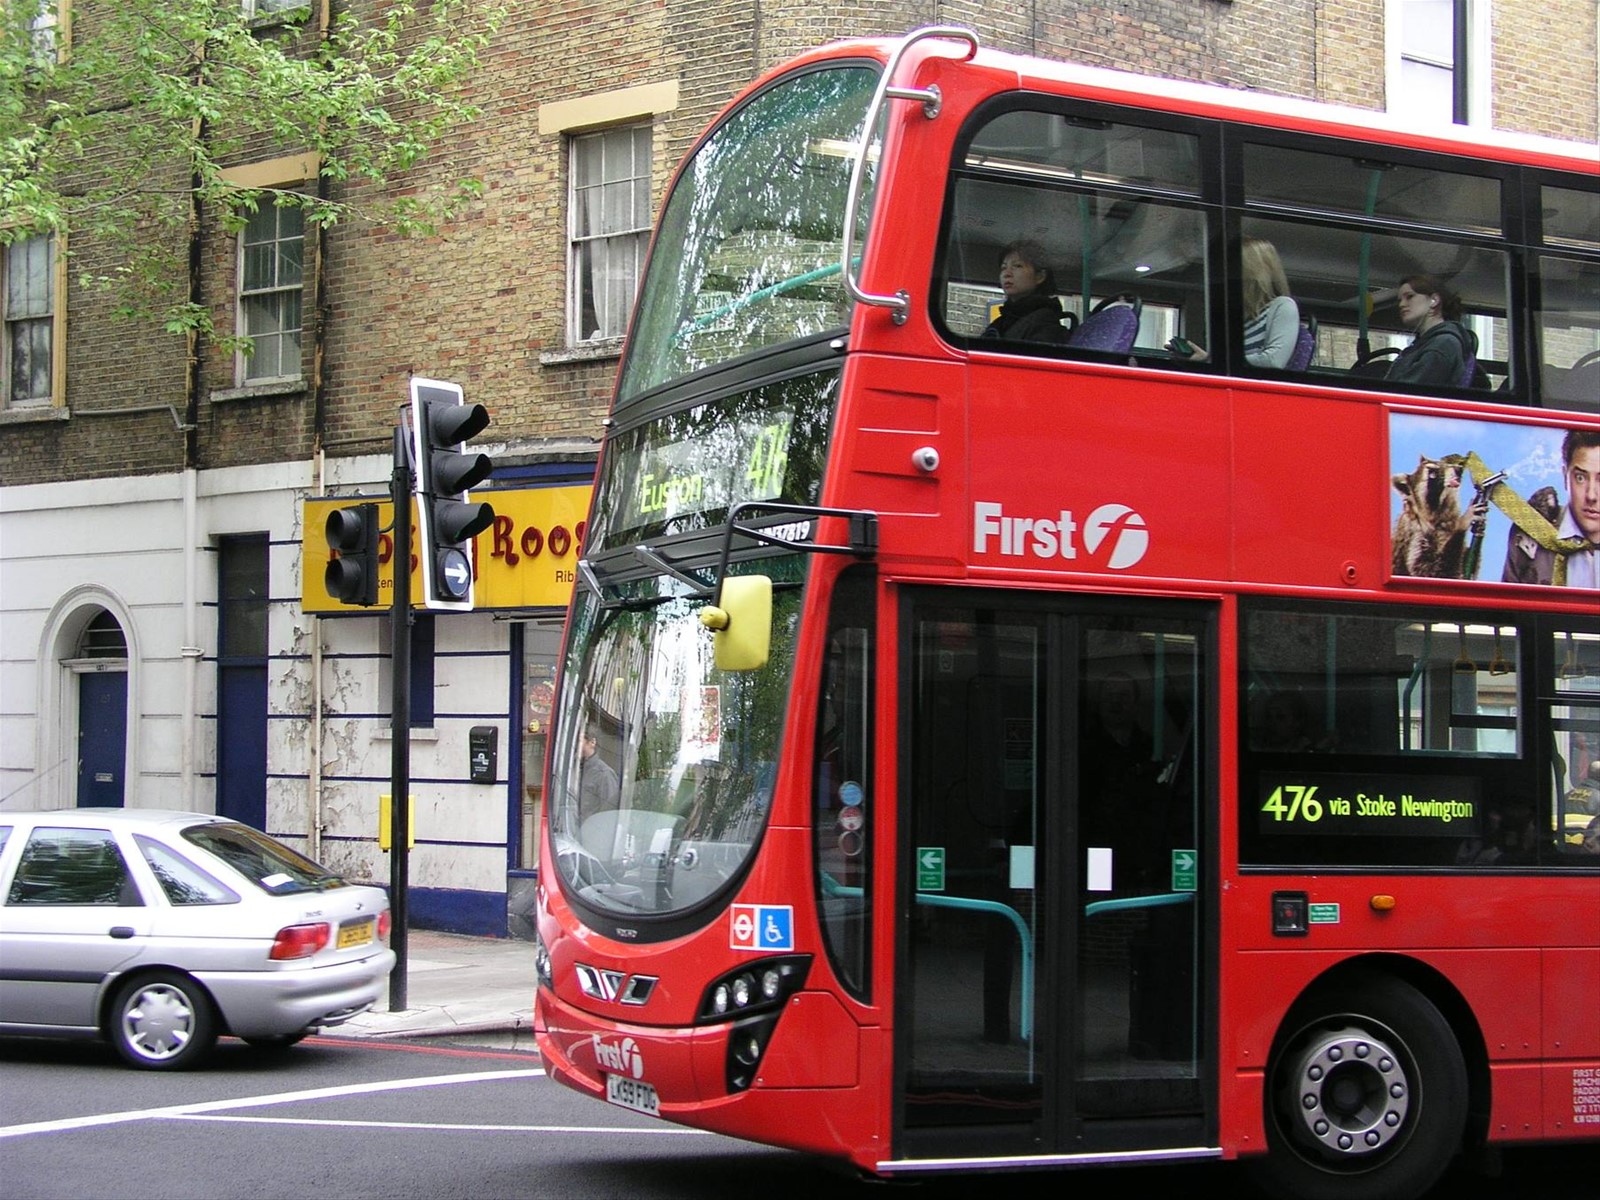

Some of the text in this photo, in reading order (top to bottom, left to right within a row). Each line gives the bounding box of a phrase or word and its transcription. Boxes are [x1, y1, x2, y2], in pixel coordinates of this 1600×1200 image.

[641, 473, 703, 513] Euston
[974, 501, 1076, 560] First
[1261, 786, 1473, 823] 476 via Stoke Newington
[592, 1033, 625, 1072] First
